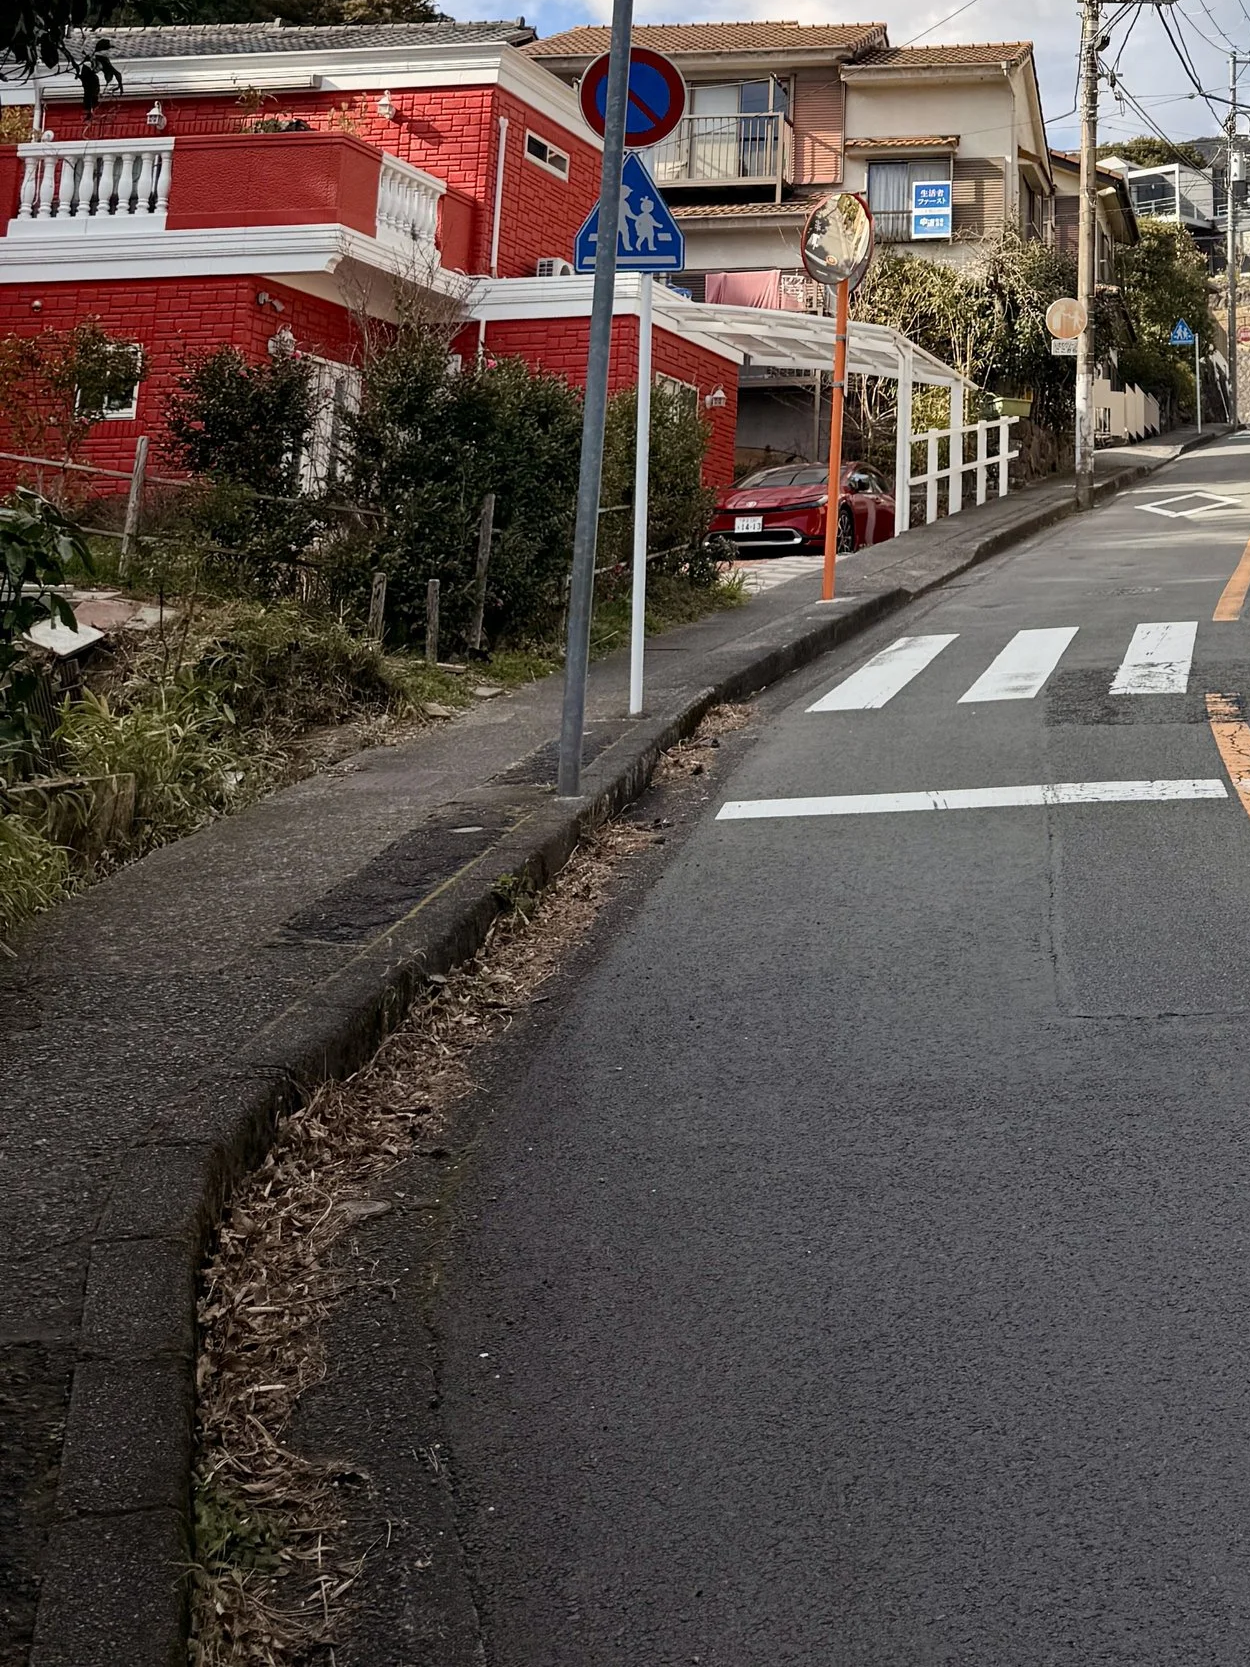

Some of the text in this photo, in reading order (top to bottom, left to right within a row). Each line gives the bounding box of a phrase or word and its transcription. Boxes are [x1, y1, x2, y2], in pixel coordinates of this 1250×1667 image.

[920, 189, 944, 197] 生活者
[918, 197, 946, 205] ファースト
